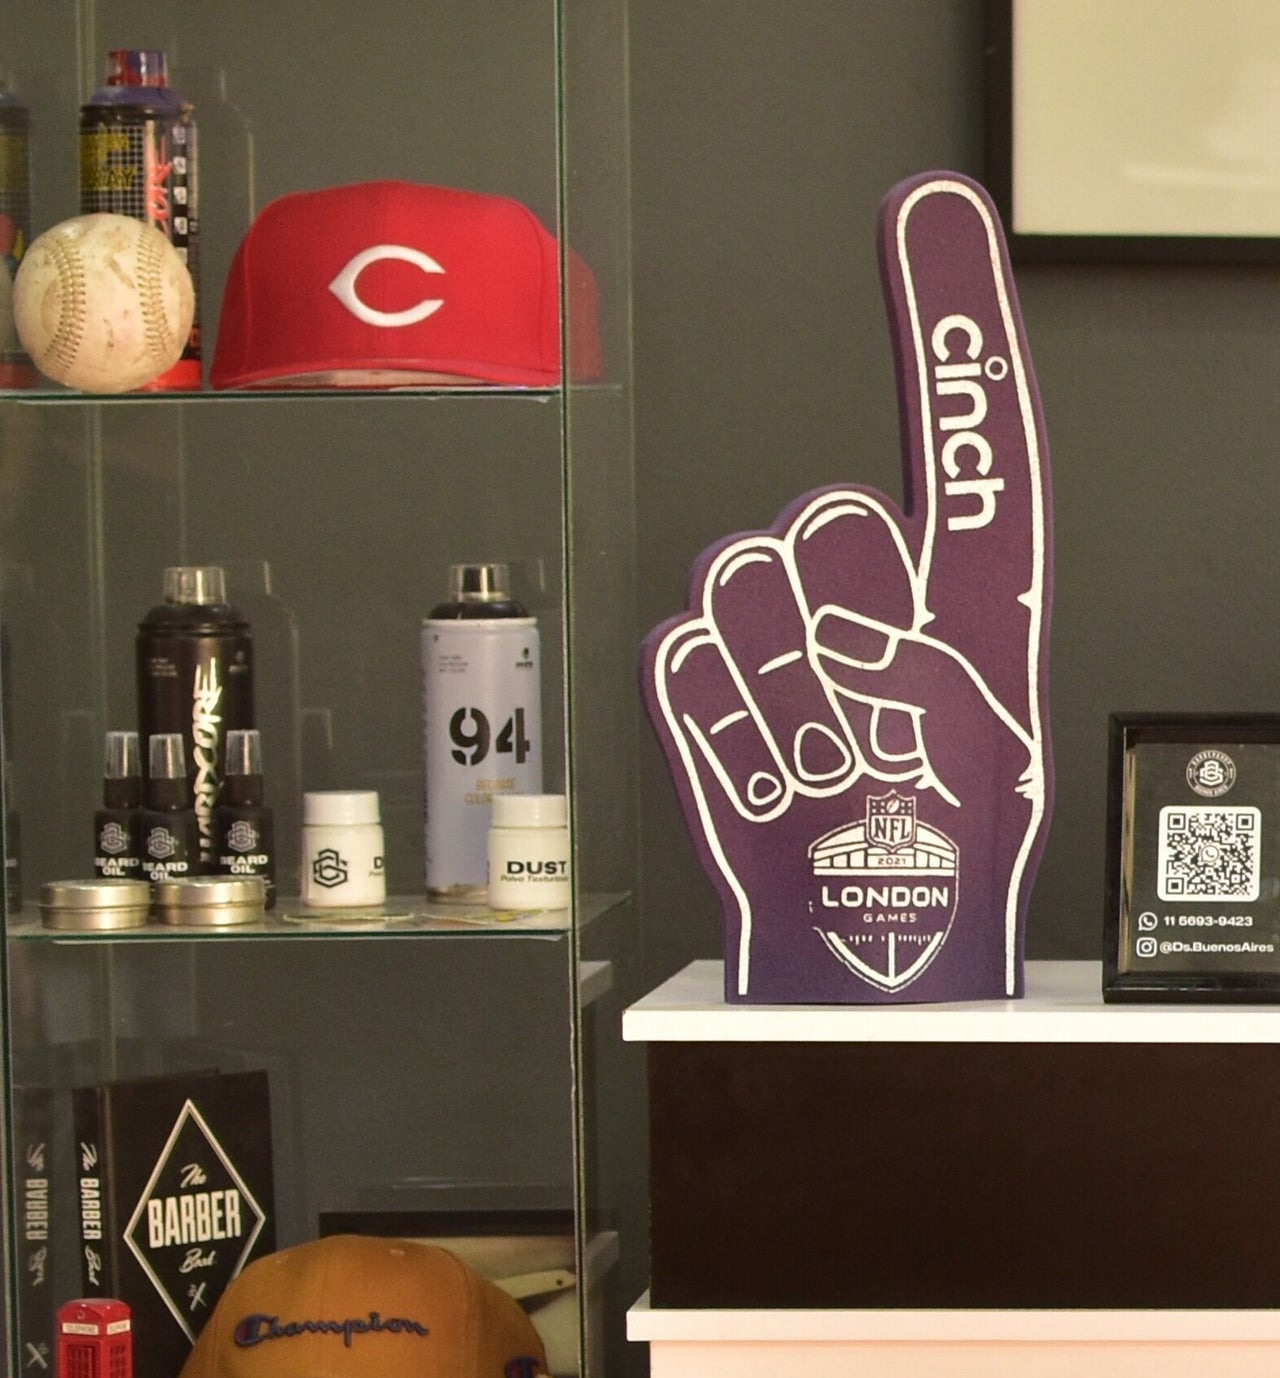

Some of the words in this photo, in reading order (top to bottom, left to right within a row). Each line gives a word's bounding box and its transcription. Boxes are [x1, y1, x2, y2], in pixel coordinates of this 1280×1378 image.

[328, 244, 446, 328] C
[930, 312, 1009, 533] cinch
[449, 706, 531, 766] 94
[873, 816, 911, 843] NFL
[102, 865, 126, 876] OIL
[230, 863, 256, 875] OIL
[506, 860, 567, 875] DUST
[877, 857, 907, 865] 2021
[821, 885, 949, 908] LONDON
[862, 912, 918, 924] GAMES
[1163, 916, 1176, 926] 11
[1159, 941, 1275, 955] @Ds.BuenosAires
[179, 1163, 208, 1189] The
[79, 1177, 103, 1240] BARBER
[147, 1188, 242, 1249] BARBER
[234, 1311, 430, 1348] Champion
